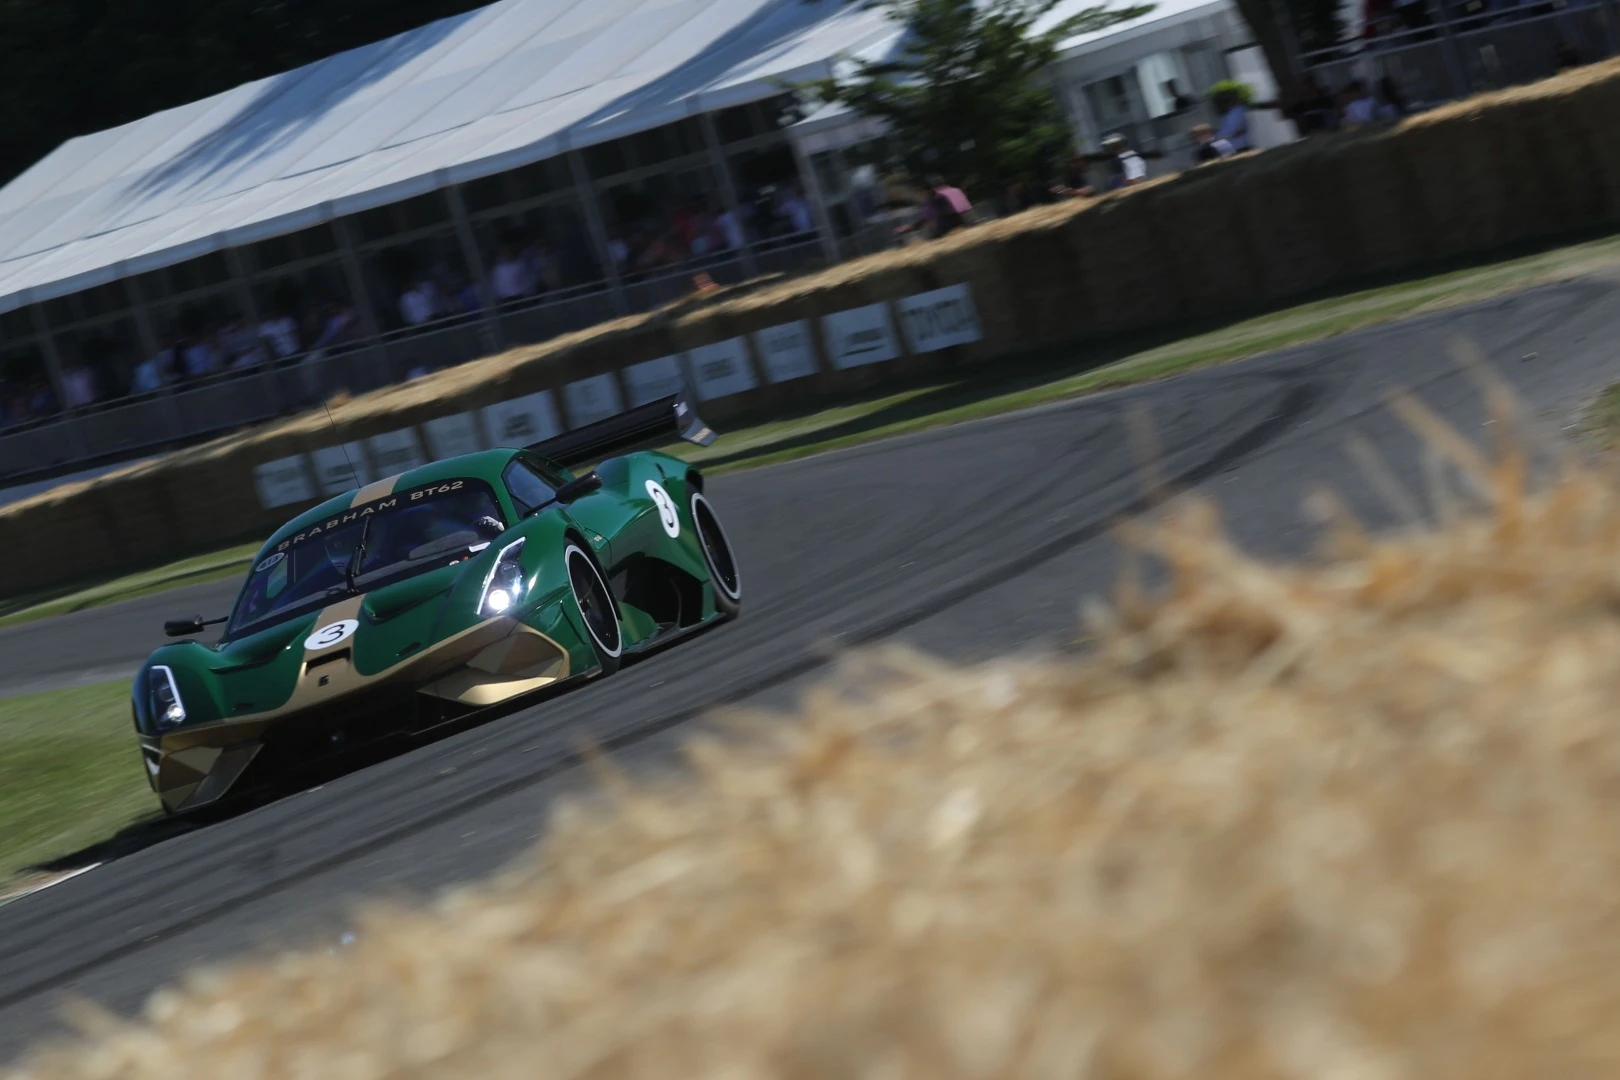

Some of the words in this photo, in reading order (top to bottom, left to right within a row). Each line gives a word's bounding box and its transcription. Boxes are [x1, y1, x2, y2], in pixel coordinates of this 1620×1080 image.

[277, 499, 397, 551] BRABHAM
[410, 480, 464, 501] BT62
[652, 487, 675, 529] 3
[317, 623, 346, 645] 3
